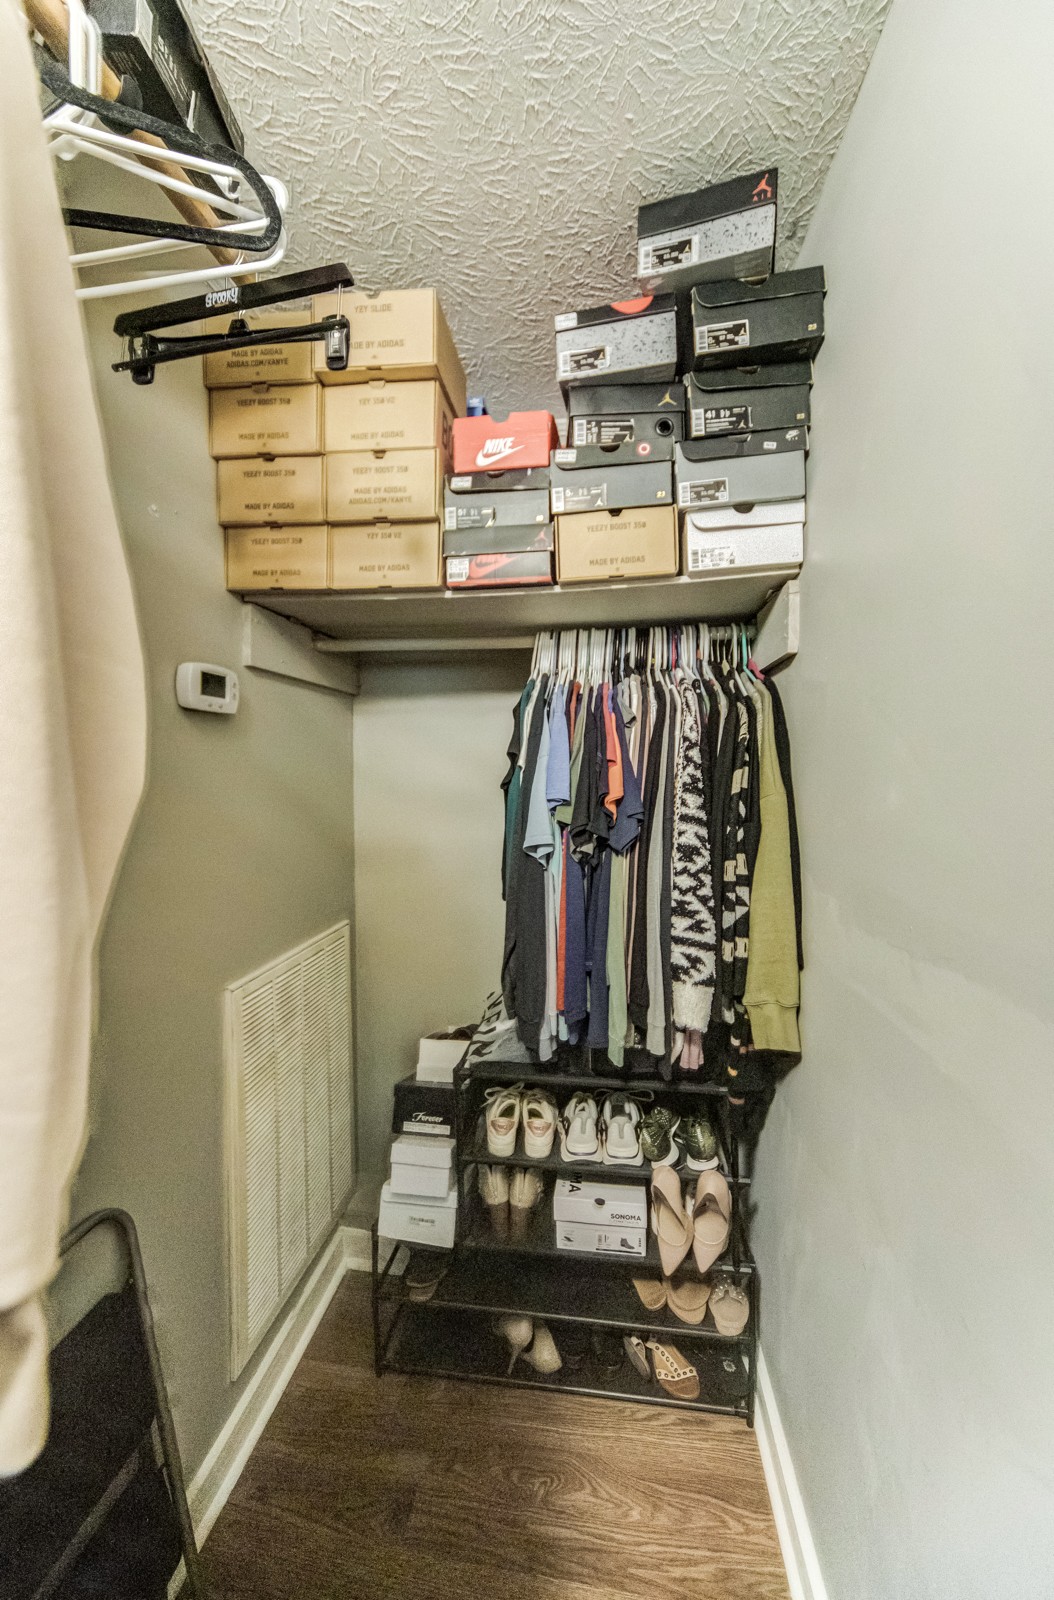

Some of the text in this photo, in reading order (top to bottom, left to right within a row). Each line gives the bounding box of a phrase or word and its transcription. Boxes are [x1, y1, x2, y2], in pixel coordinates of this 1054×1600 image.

[205, 287, 238, 308] SPOOKY
[354, 303, 392, 313] YZY SLIDE
[350, 339, 405, 350] ADE BY ADIDAS
[250, 348, 258, 356] BY
[226, 358, 289, 368] ADIDAS.COM/KANYE
[236, 398, 256, 407] YEEZY
[380, 430, 404, 438] ADIDAS
[483, 437, 516, 454] NIKE
[243, 470, 262, 478] YEEZY
[352, 466, 372, 475] YEEZY
[374, 466, 394, 474] BOOST
[587, 521, 647, 533] YEEZY BOOST 350
[367, 532, 378, 540] YZY
[589, 556, 646, 566] MADE BY ADIDAS
[387, 564, 410, 572] ADIDAS
[412, 1112, 444, 1123] Forever
[610, 1213, 642, 1222] SONOMA
